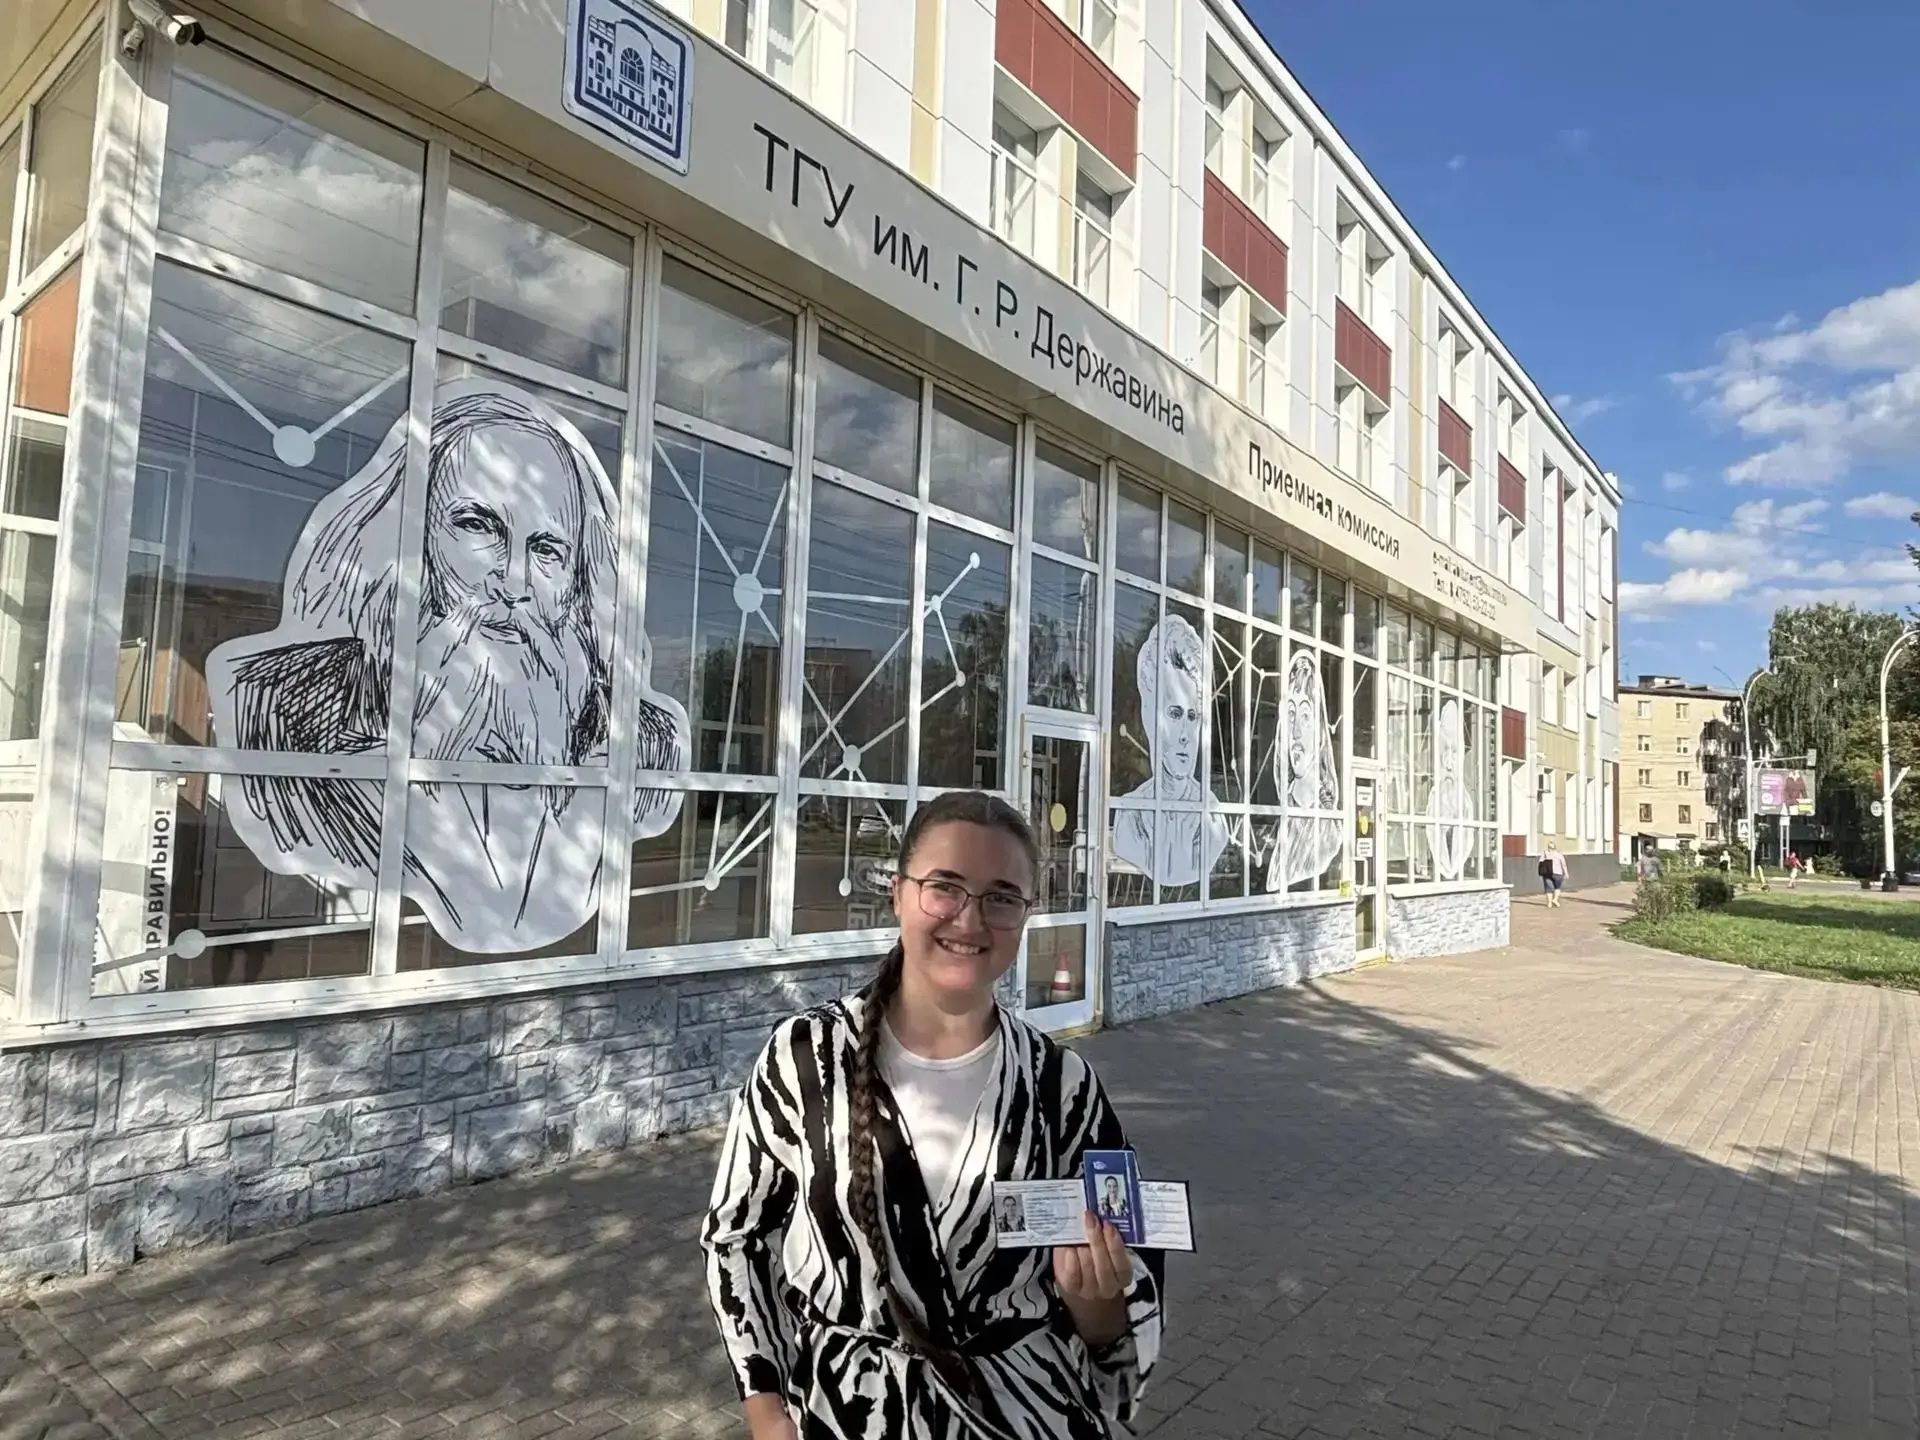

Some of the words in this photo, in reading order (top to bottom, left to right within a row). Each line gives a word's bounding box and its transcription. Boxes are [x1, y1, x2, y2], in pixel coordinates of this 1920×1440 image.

[753, 122, 855, 228] ТГУ
[873, 214, 939, 291] им.
[957, 255, 980, 315] Г.
[996, 279, 1020, 339] Р.
[1031, 305, 1185, 435] Державина
[1249, 440, 1333, 521] Приемная
[1337, 503, 1400, 560] комиссия
